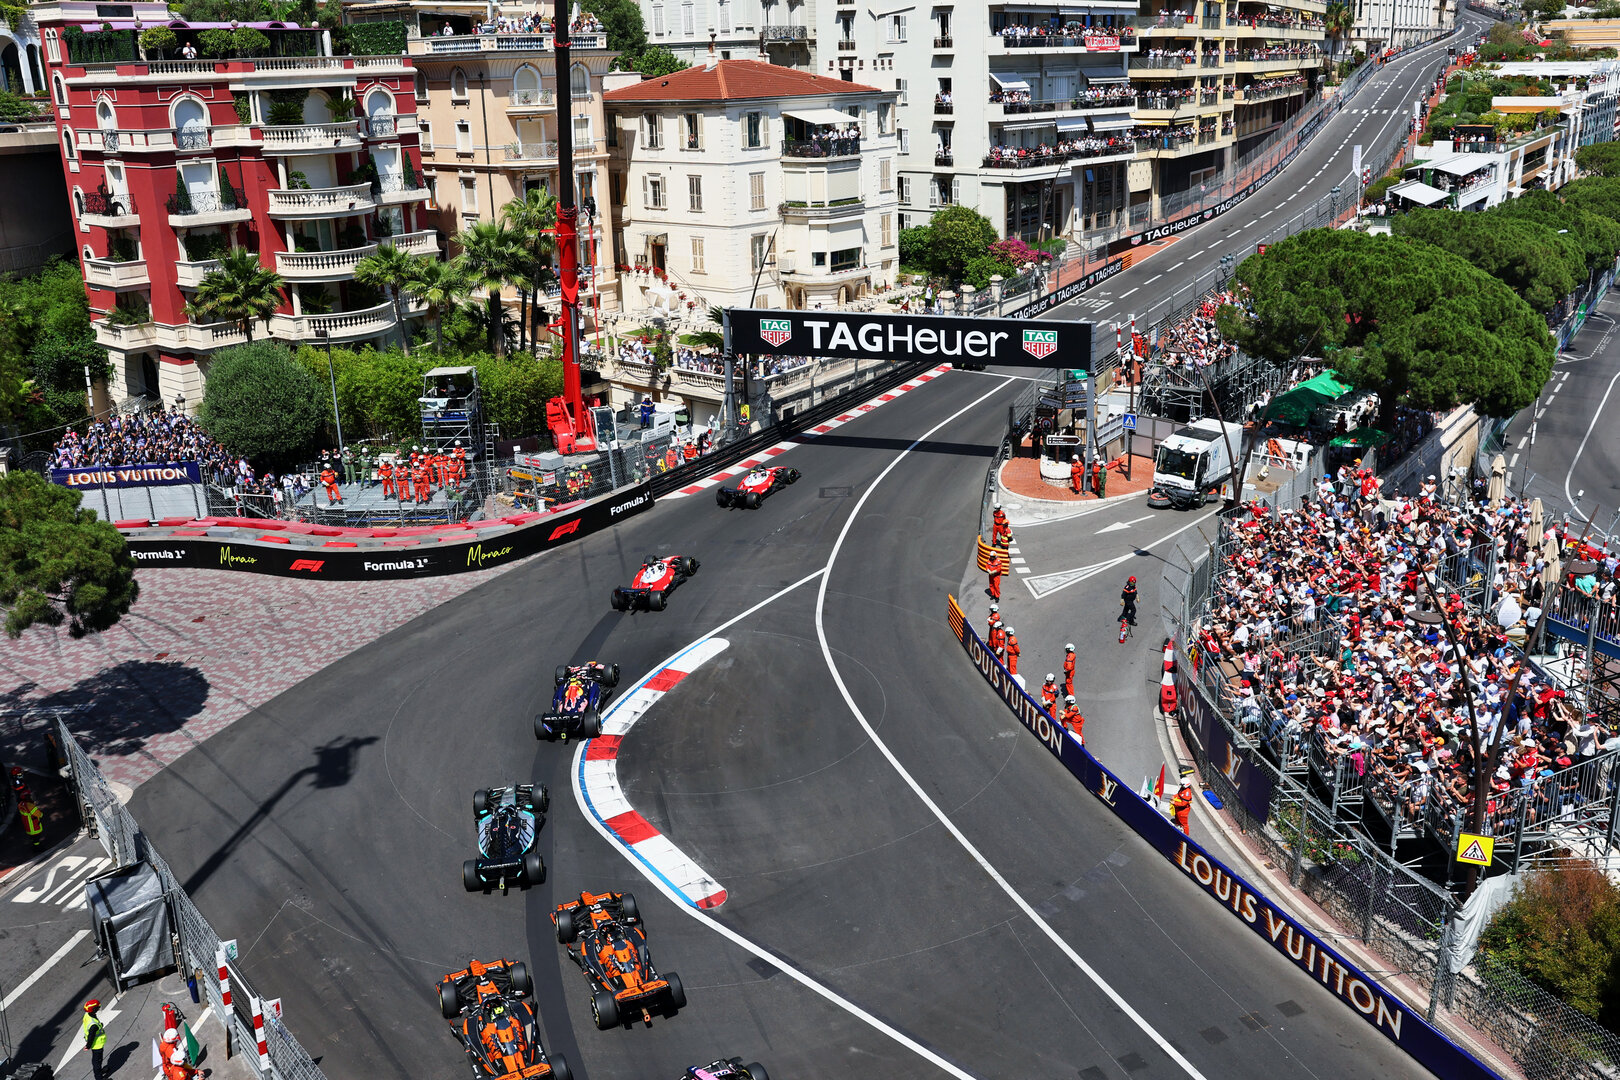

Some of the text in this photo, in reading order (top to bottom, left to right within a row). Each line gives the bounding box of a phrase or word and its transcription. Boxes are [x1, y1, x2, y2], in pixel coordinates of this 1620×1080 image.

[762, 320, 789, 331] TAG
[762, 331, 790, 345] HEUER
[1025, 331, 1055, 342] TAG
[1024, 342, 1056, 357] HEUER
[69, 467, 188, 486] LOUIS VUITTON
[610, 497, 644, 516] Formula
[130, 550, 174, 560] Formula
[220, 546, 257, 568] Monaco
[467, 544, 513, 567] Monaco
[364, 560, 414, 571] Formula
[969, 634, 1063, 756] LOUIS VUITTON
[1180, 841, 1402, 1040] LOUIS VUITTON
